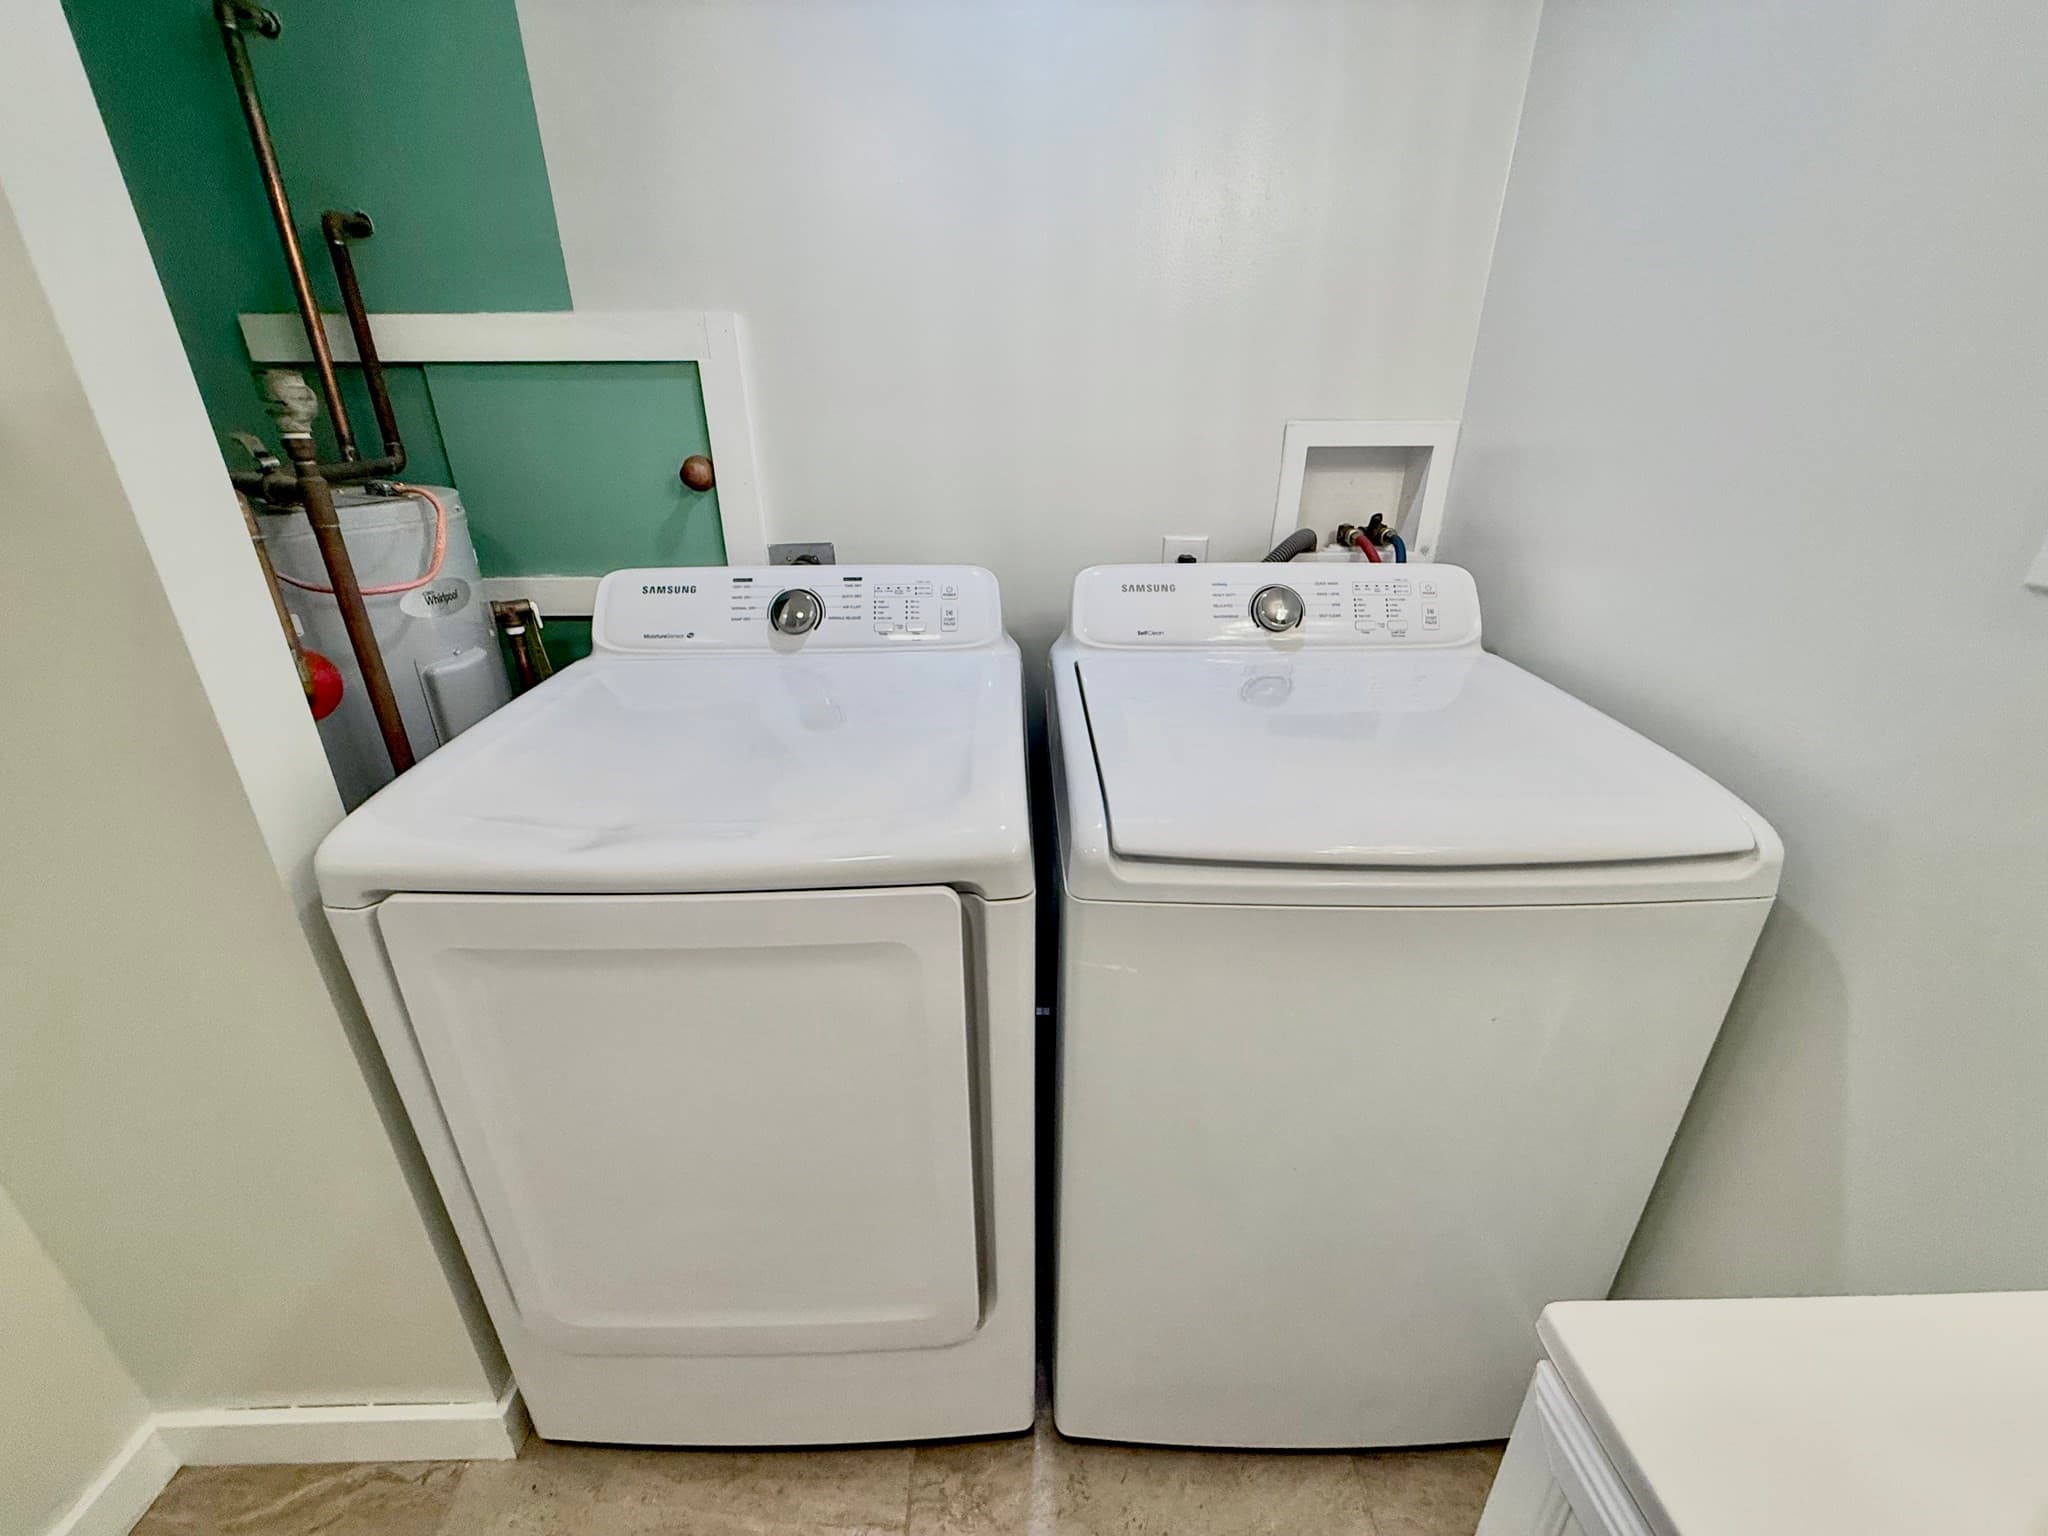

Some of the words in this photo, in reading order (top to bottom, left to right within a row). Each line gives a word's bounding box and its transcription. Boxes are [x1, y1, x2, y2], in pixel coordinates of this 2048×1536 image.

[642, 585, 697, 594] SAMSUNG
[1121, 584, 1176, 593] SAMSUNG
[423, 588, 459, 606] Whirlpool
